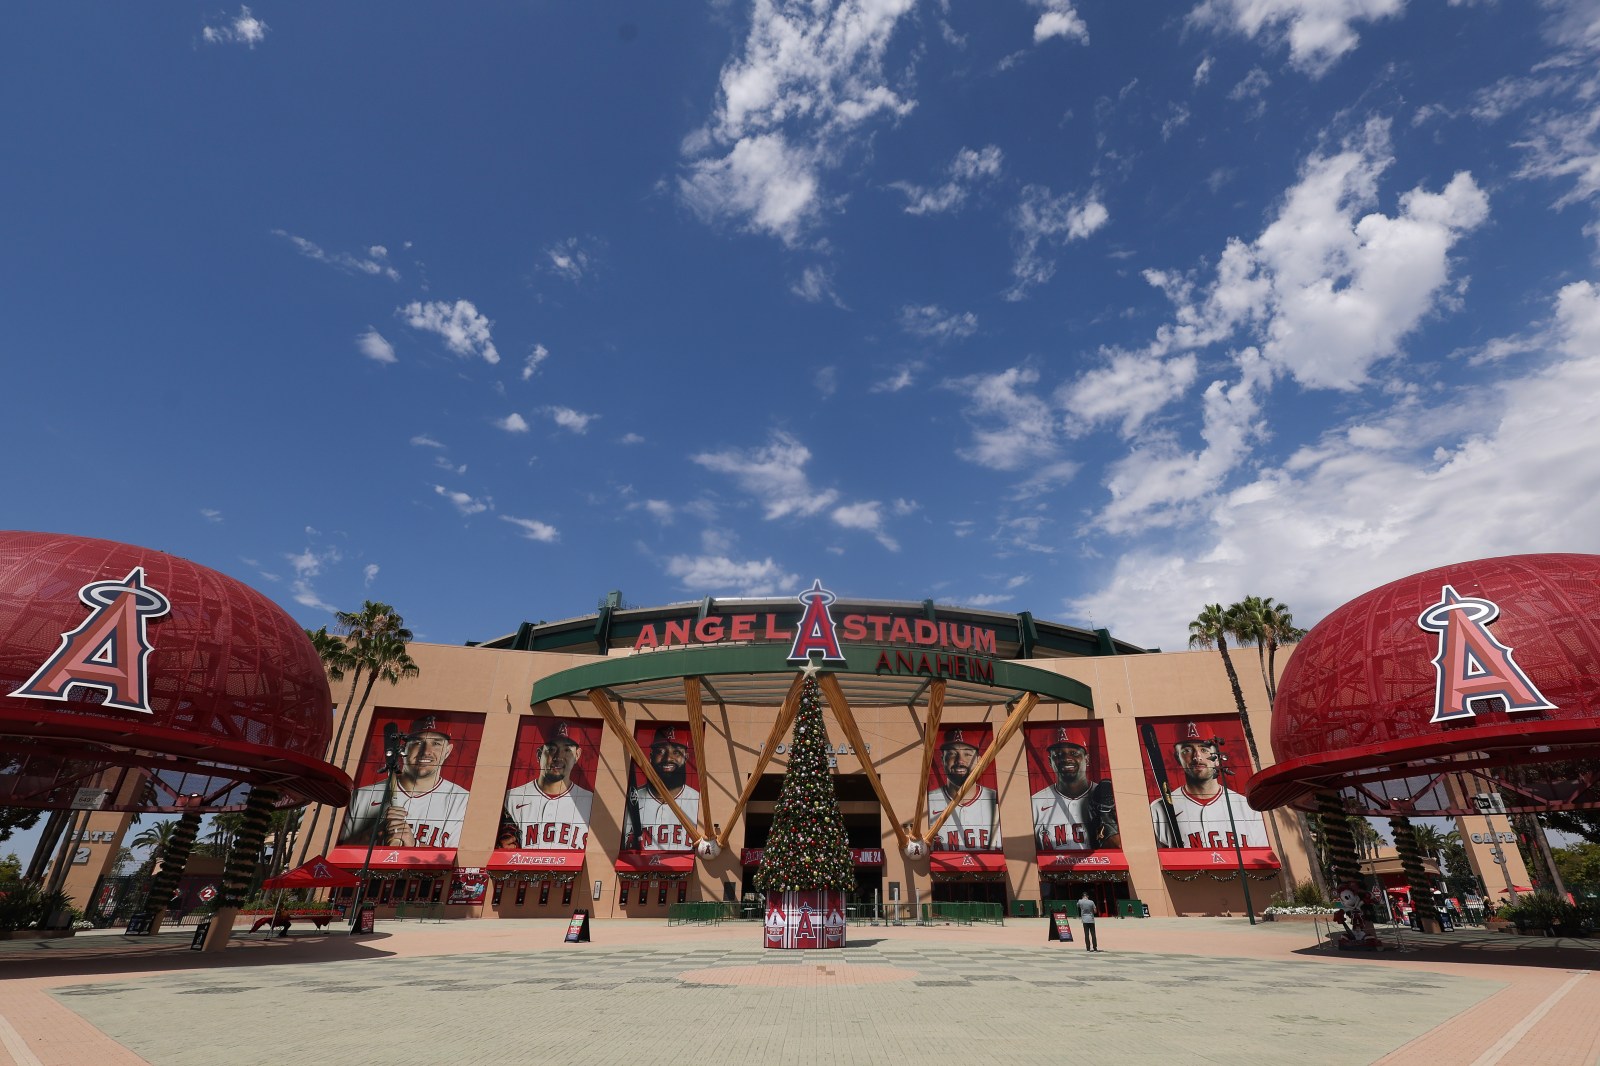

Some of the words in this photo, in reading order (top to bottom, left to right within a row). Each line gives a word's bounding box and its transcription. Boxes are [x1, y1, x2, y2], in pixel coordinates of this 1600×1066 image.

[786, 579, 846, 660] A
[634, 614, 792, 650] ANGEL
[843, 614, 997, 654] STADIUM
[876, 649, 995, 682] ANAHEIM
[73, 847, 91, 864] 2
[860, 851, 873, 863] JUNE
[873, 851, 881, 863] 24
[203, 888, 212, 898] 2
